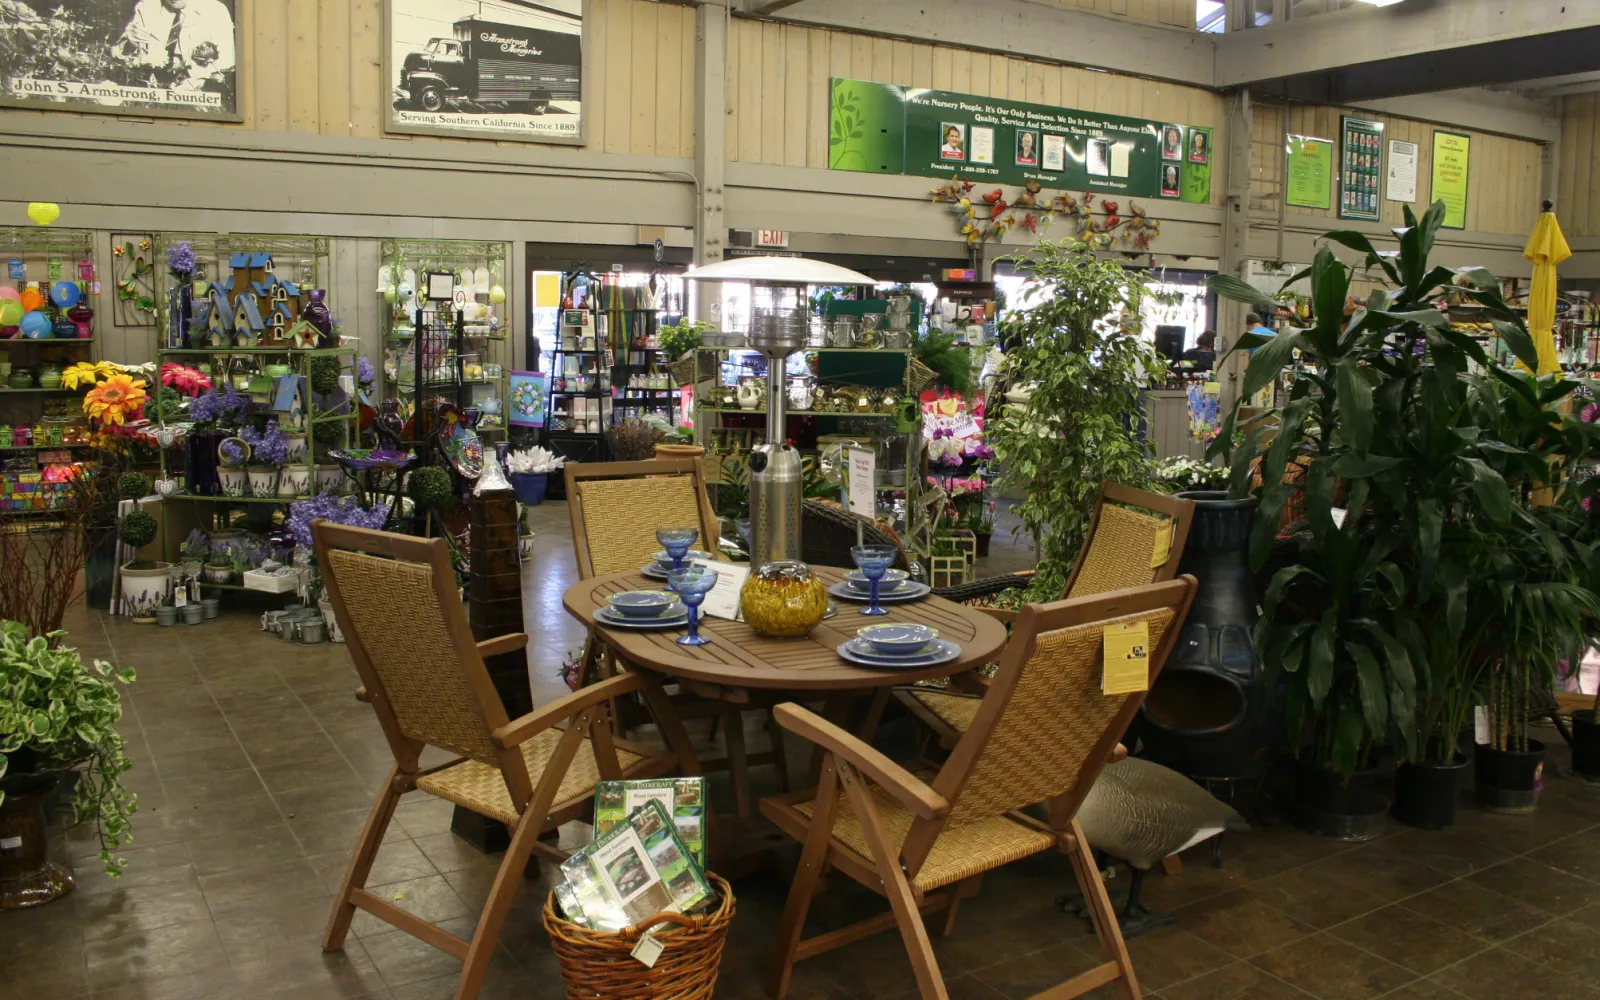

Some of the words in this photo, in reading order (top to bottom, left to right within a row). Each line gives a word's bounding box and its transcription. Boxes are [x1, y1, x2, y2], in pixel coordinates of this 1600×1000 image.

[480, 32, 529, 48] Armstrong
[14, 79, 51, 93] John
[57, 82, 74, 94] S.
[79, 84, 160, 102] Armstrong,
[166, 90, 220, 105] Founder
[400, 112, 436, 123] Serving
[438, 115, 480, 126] Southern
[482, 117, 526, 129] California
[528, 121, 553, 130] Since
[555, 123, 576, 131] 1889
[912, 97, 930, 106] We're
[931, 98, 958, 109] Nursery
[960, 101, 984, 112] People.
[985, 105, 995, 114] It's
[997, 107, 1009, 116] Our
[1010, 109, 1025, 119] Only
[1027, 111, 1056, 122] Business.
[1057, 115, 1067, 123] We
[1068, 117, 1077, 125] Do
[1077, 118, 1083, 126] It
[1084, 119, 1102, 128] Better
[1103, 122, 1118, 130] Than
[1119, 124, 1140, 133] Anyone
[975, 114, 1000, 125] Quality,
[1001, 117, 1025, 127] Service
[1026, 121, 1039, 129] And
[1041, 122, 1069, 133] Selection
[1070, 126, 1087, 135] Since
[931, 162, 955, 171] President
[762, 230, 784, 245] EXIT
